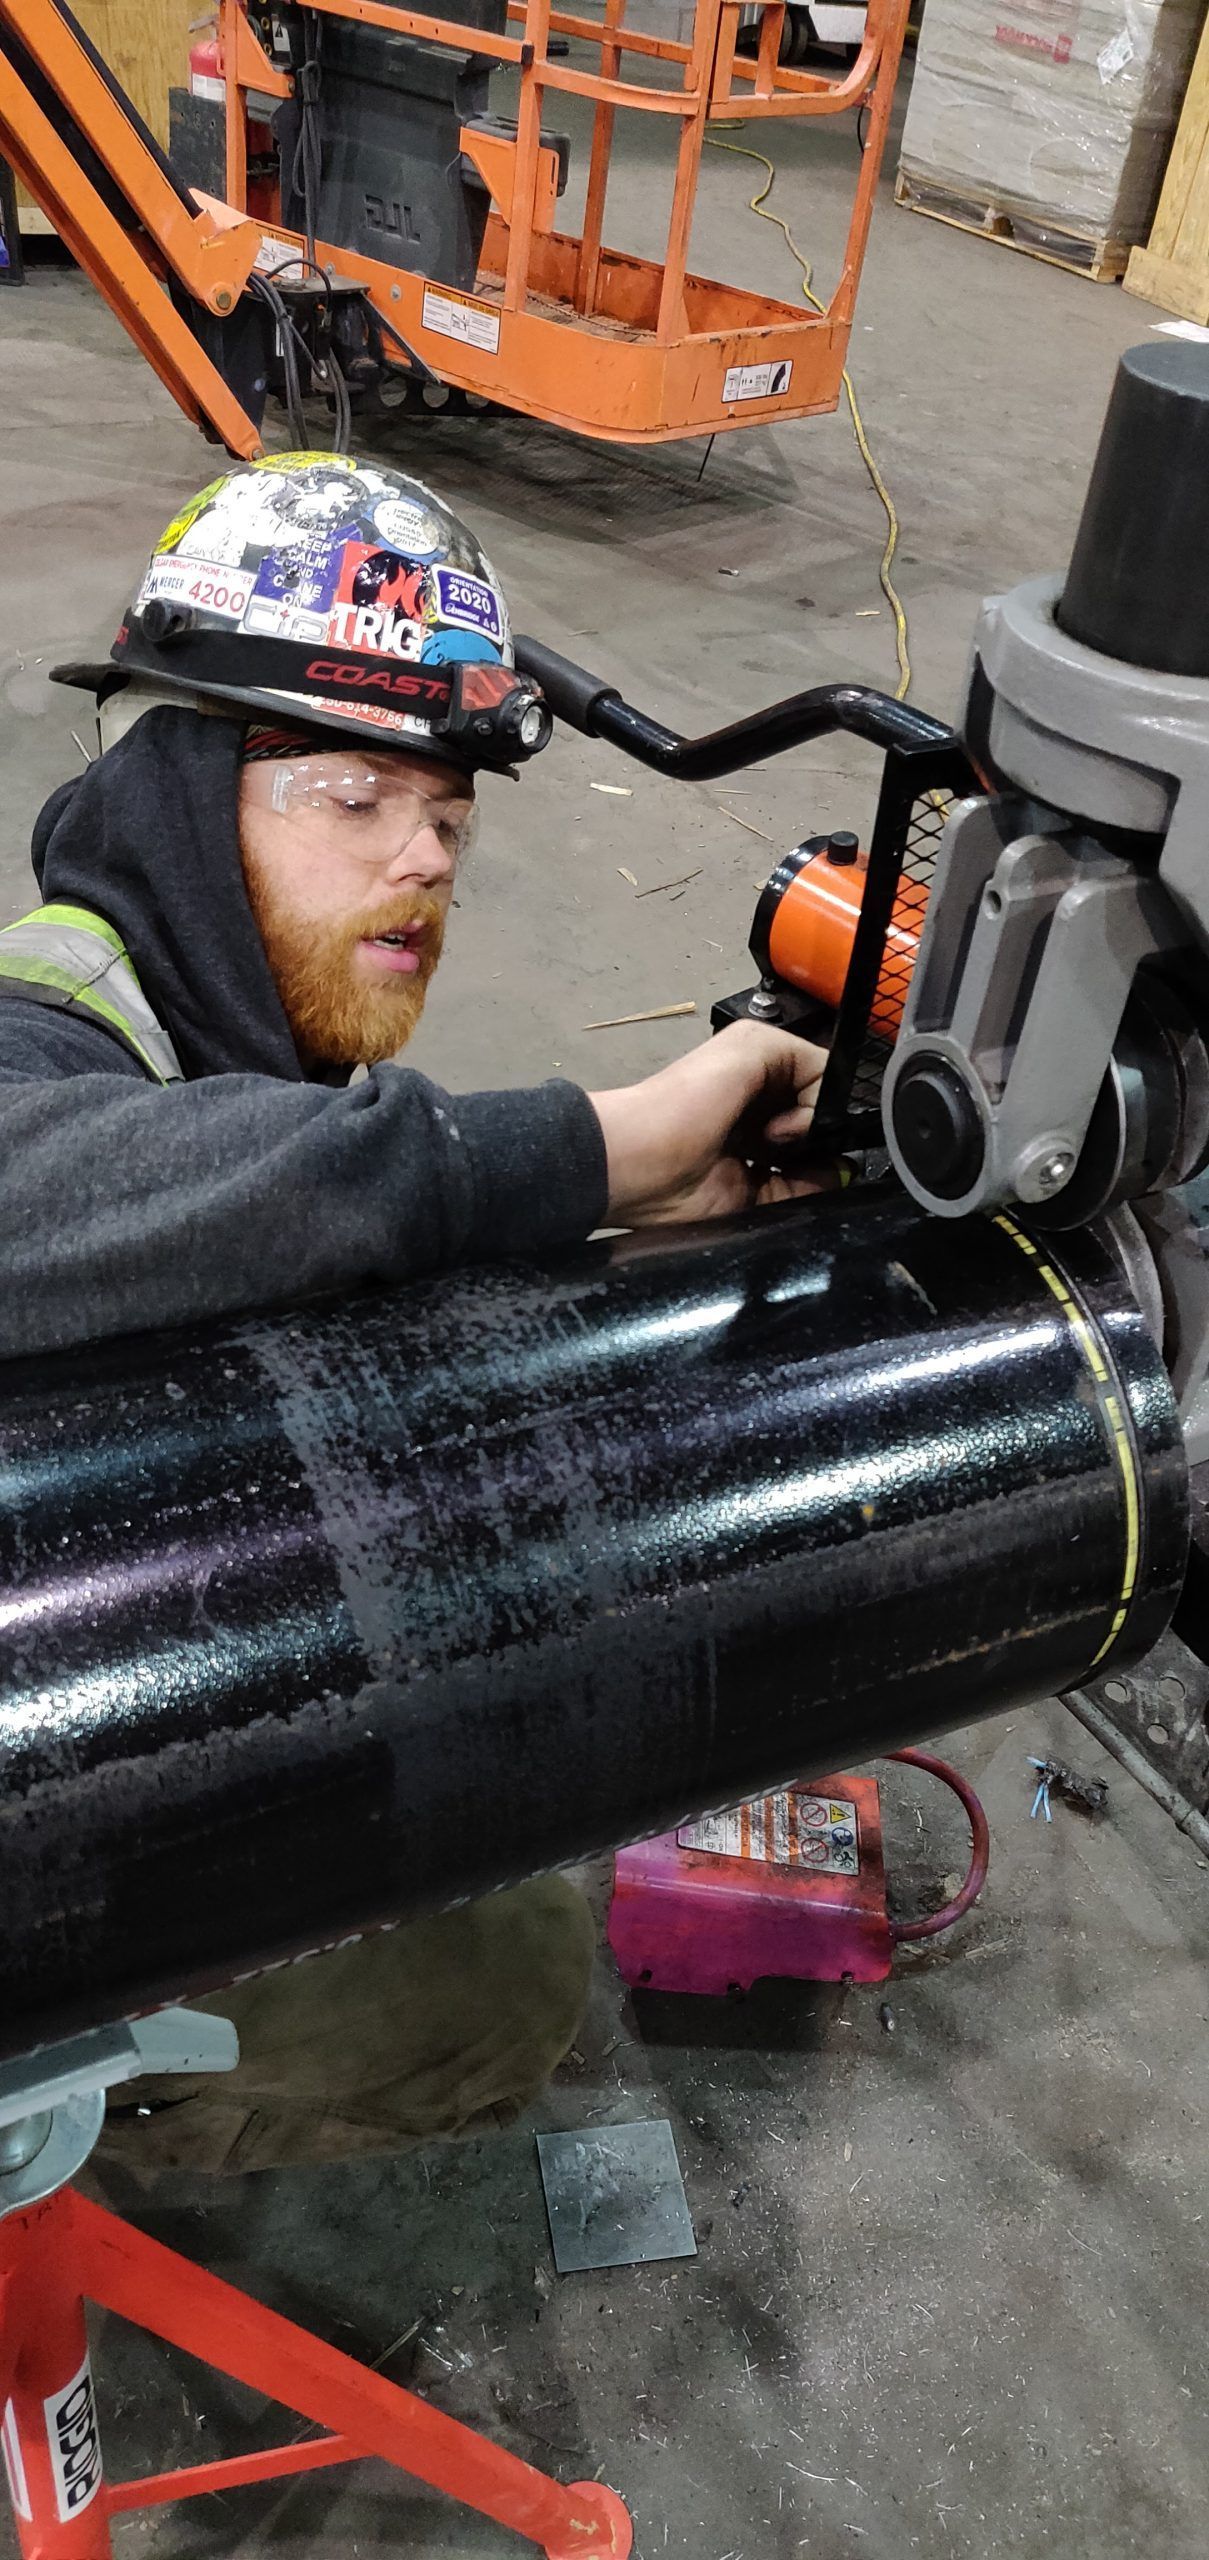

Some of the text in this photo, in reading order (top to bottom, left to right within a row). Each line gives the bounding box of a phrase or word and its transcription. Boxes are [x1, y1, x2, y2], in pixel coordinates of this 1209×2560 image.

[189, 580, 246, 612] 4200
[448, 584, 491, 615] 2020
[56, 2375, 99, 2509] RIDGID
